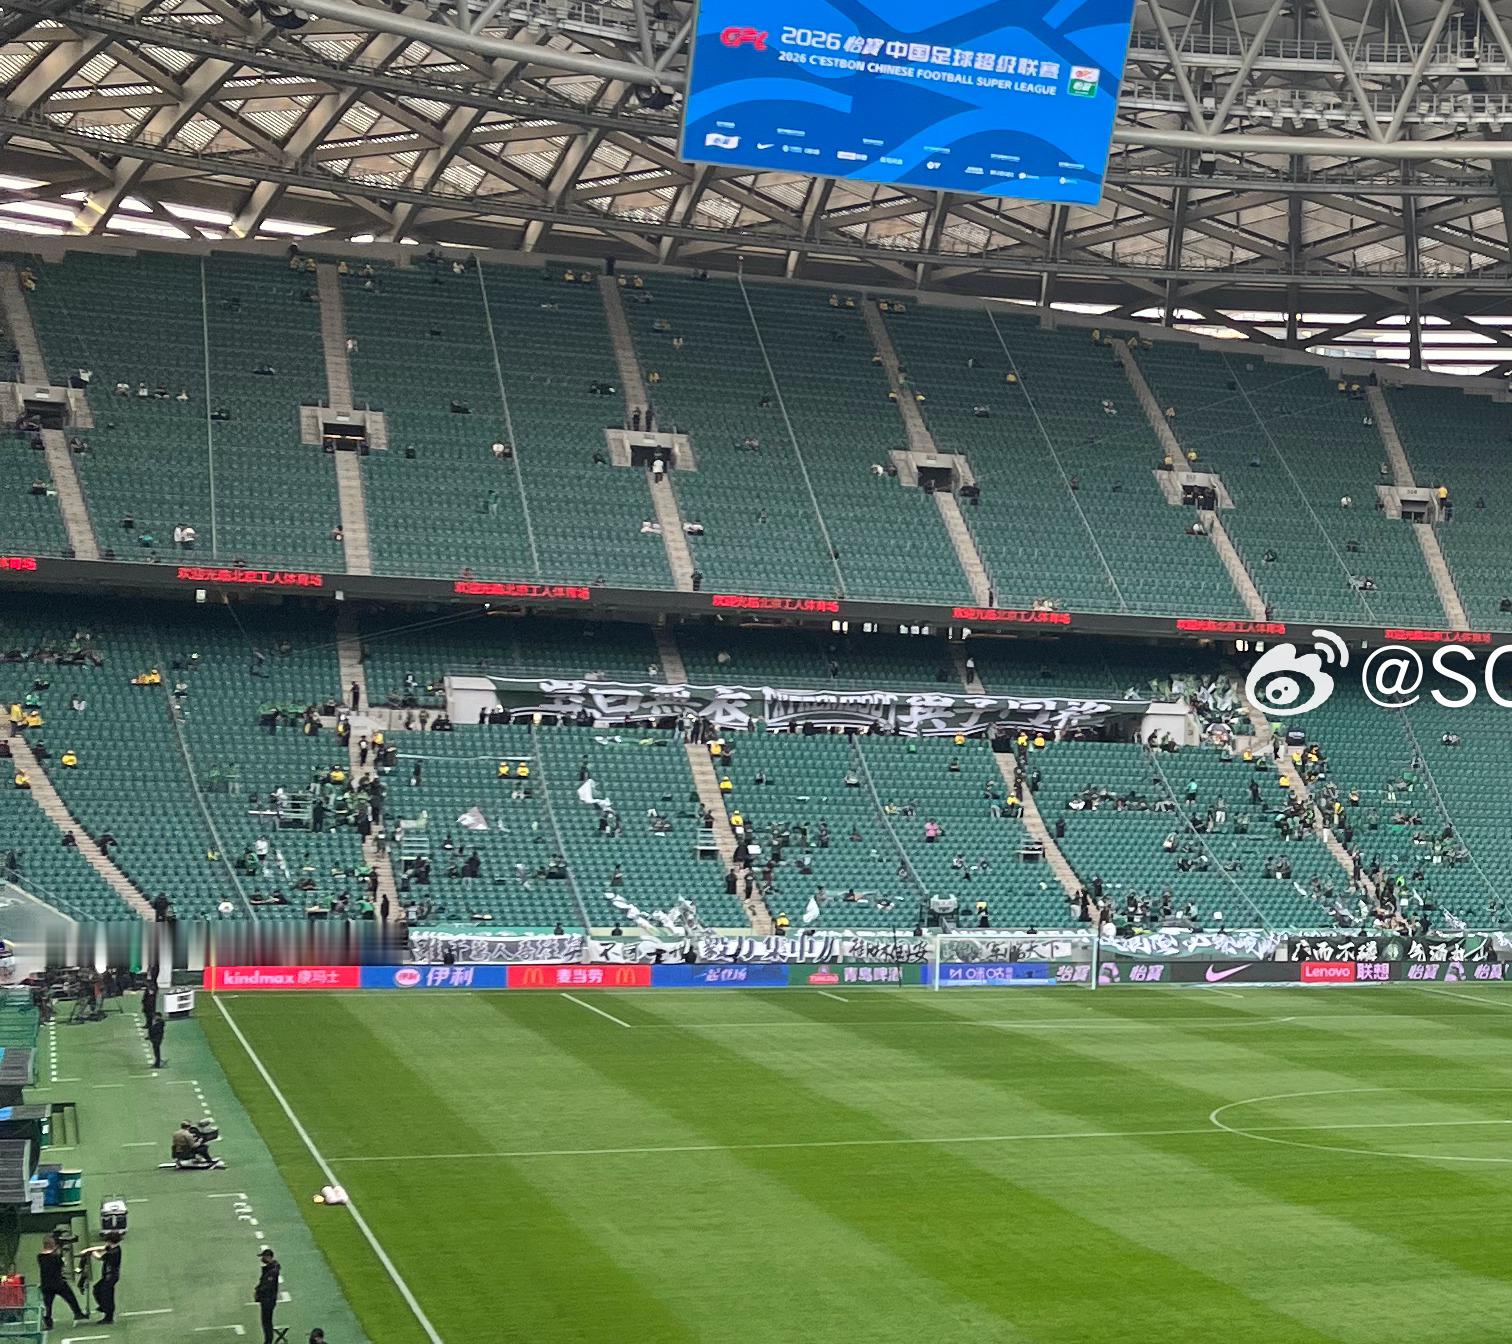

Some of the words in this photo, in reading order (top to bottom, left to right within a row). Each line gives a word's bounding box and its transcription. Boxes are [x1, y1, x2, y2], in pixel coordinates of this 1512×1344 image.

[781, 26, 842, 51] 2026
[886, 40, 1060, 80] 中国足球超级联赛
[778, 50, 807, 64] 2026
[867, 62, 914, 77] CHINESE
[916, 68, 973, 85] FOOTBALL
[976, 76, 1012, 90] SUPER
[1014, 82, 1057, 96] LEAGUE
[223, 969, 295, 985] kindmax
[297, 969, 340, 984] 康玛士
[427, 966, 475, 987] 伊利
[556, 968, 604, 984] 麦当劳
[1305, 965, 1350, 978] Lenovo
[1356, 963, 1389, 980] 联想
